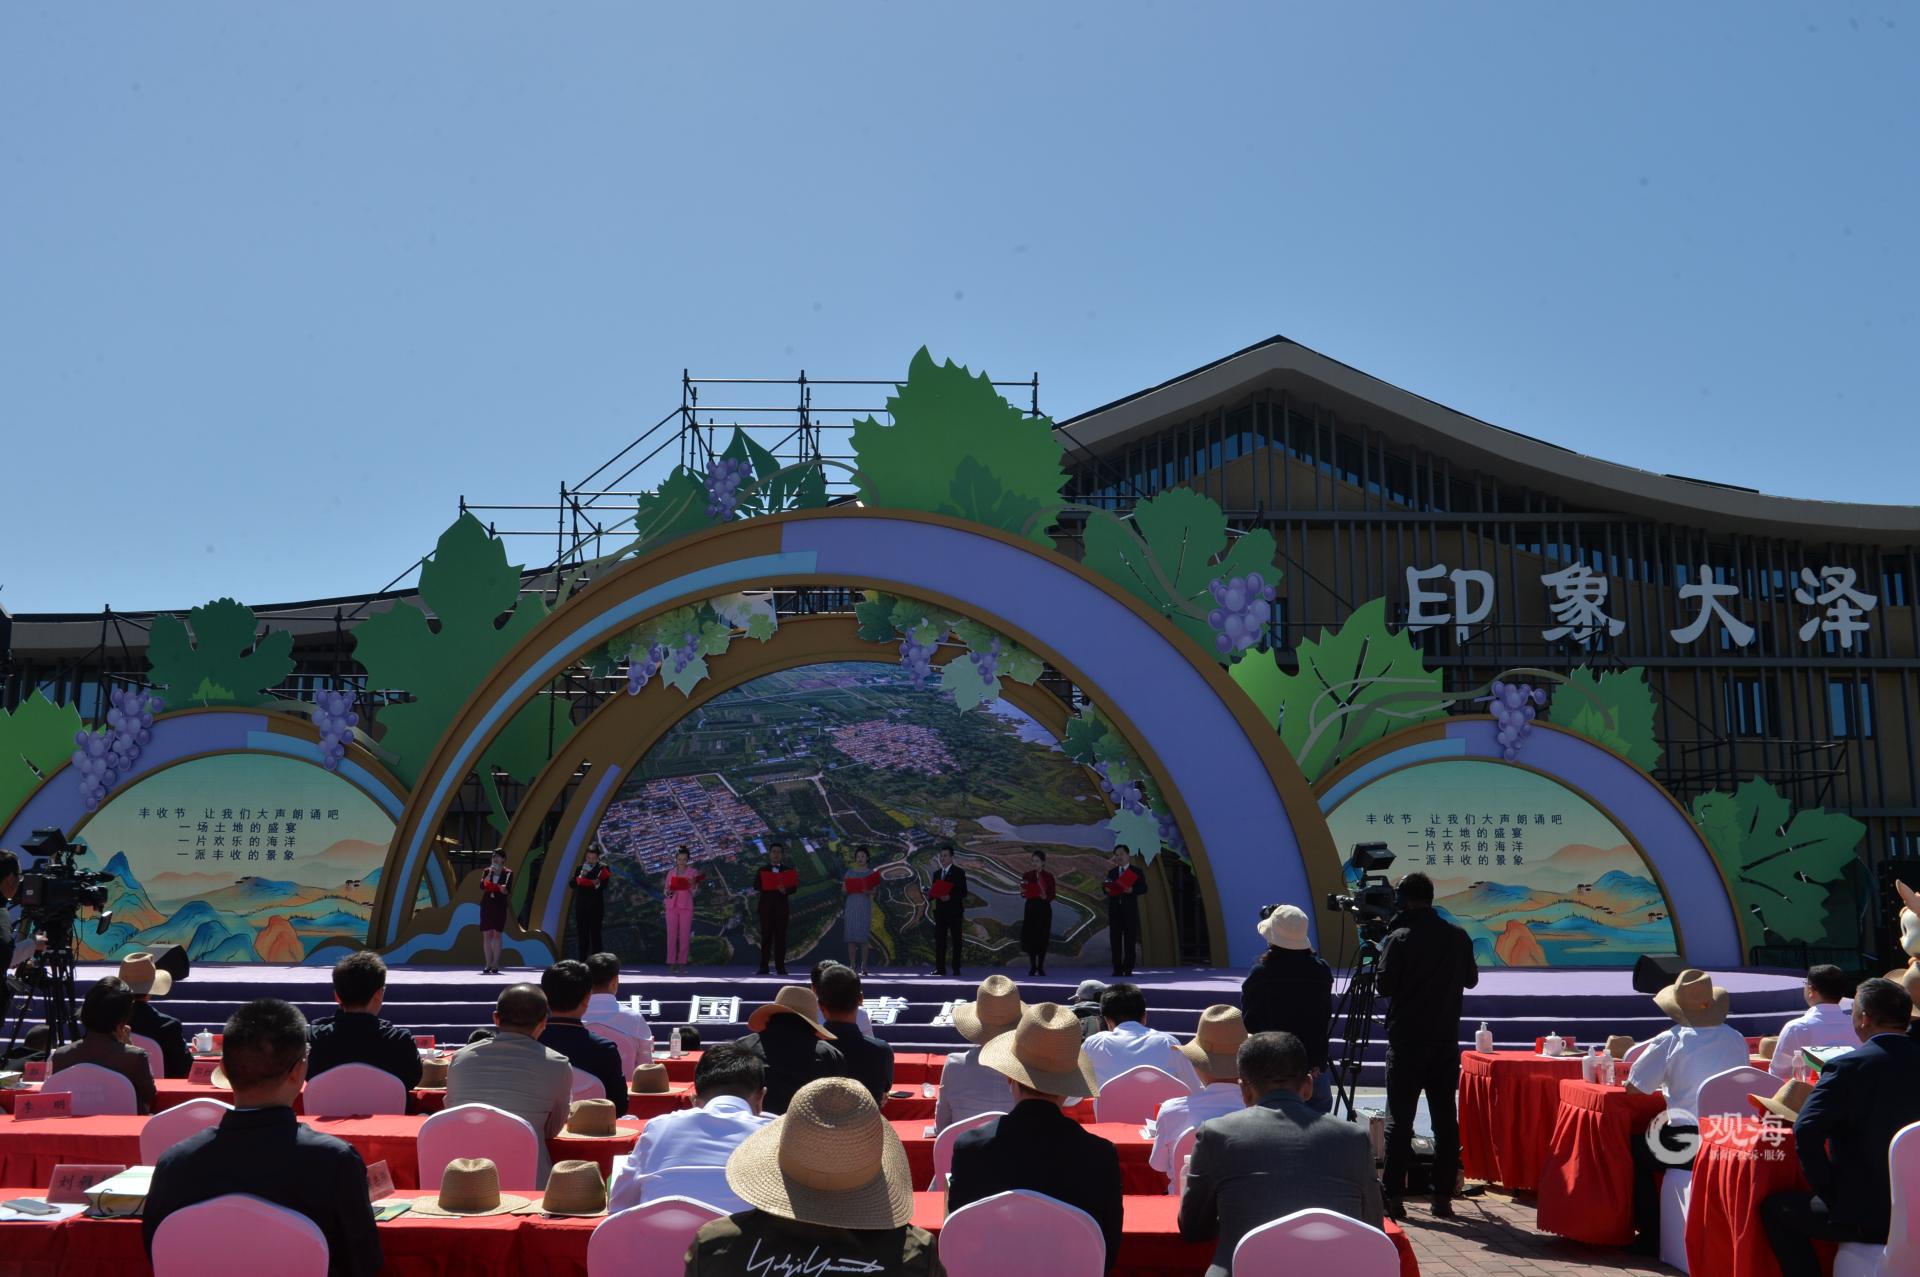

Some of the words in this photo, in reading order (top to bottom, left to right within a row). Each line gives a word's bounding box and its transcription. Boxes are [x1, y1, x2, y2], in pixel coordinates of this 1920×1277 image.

[1406, 561, 1878, 649] 印象大泽
[139, 807, 186, 819] 丰收节
[205, 808, 339, 820] 让我们大声朗诵吧
[1366, 813, 1412, 825] 丰收节
[1430, 813, 1563, 825] 让我们大声朗诵吧
[179, 822, 297, 834] 一场土地的盛宴
[1407, 827, 1523, 839] 一场土地的盛宴
[178, 835, 296, 847] 一片欢乐的海洋
[1408, 840, 1524, 852] 一片欢乐的海洋
[177, 849, 295, 861] 一派丰收的景象
[1408, 854, 1525, 866] 一派丰收的景象
